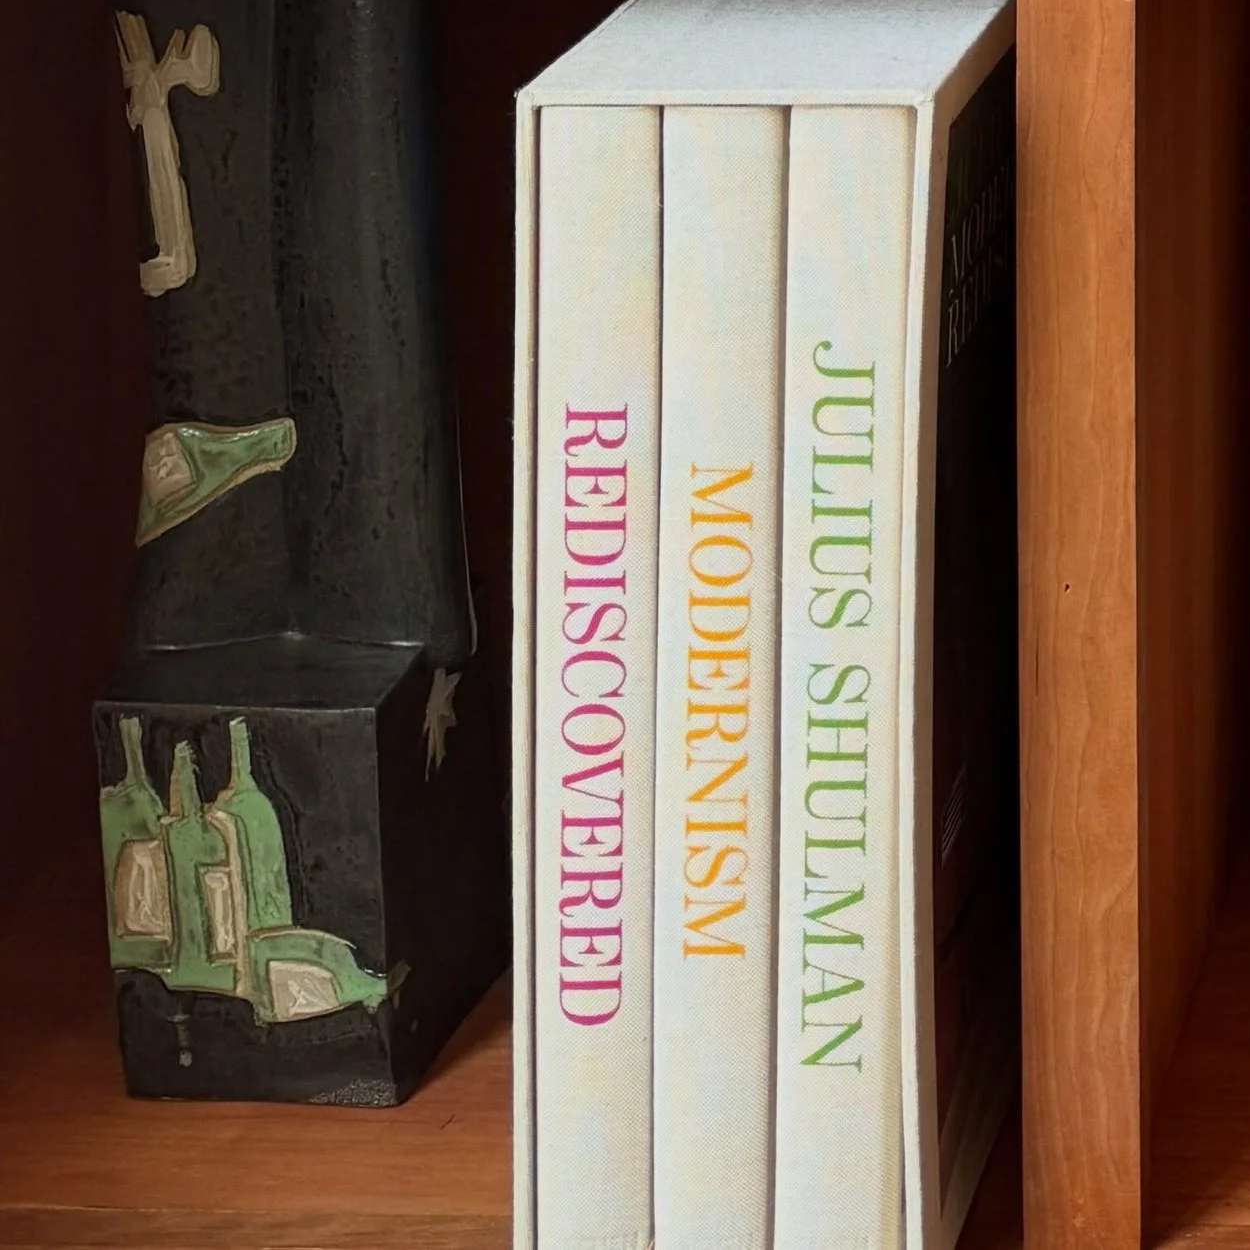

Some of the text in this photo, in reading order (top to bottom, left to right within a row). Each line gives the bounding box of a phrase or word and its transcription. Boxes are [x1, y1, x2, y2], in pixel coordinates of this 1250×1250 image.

[558, 403, 628, 1026] REDISCOVERED
[682, 462, 755, 960] MODERNISM
[801, 340, 876, 1072] JULIUS SHULMAN
